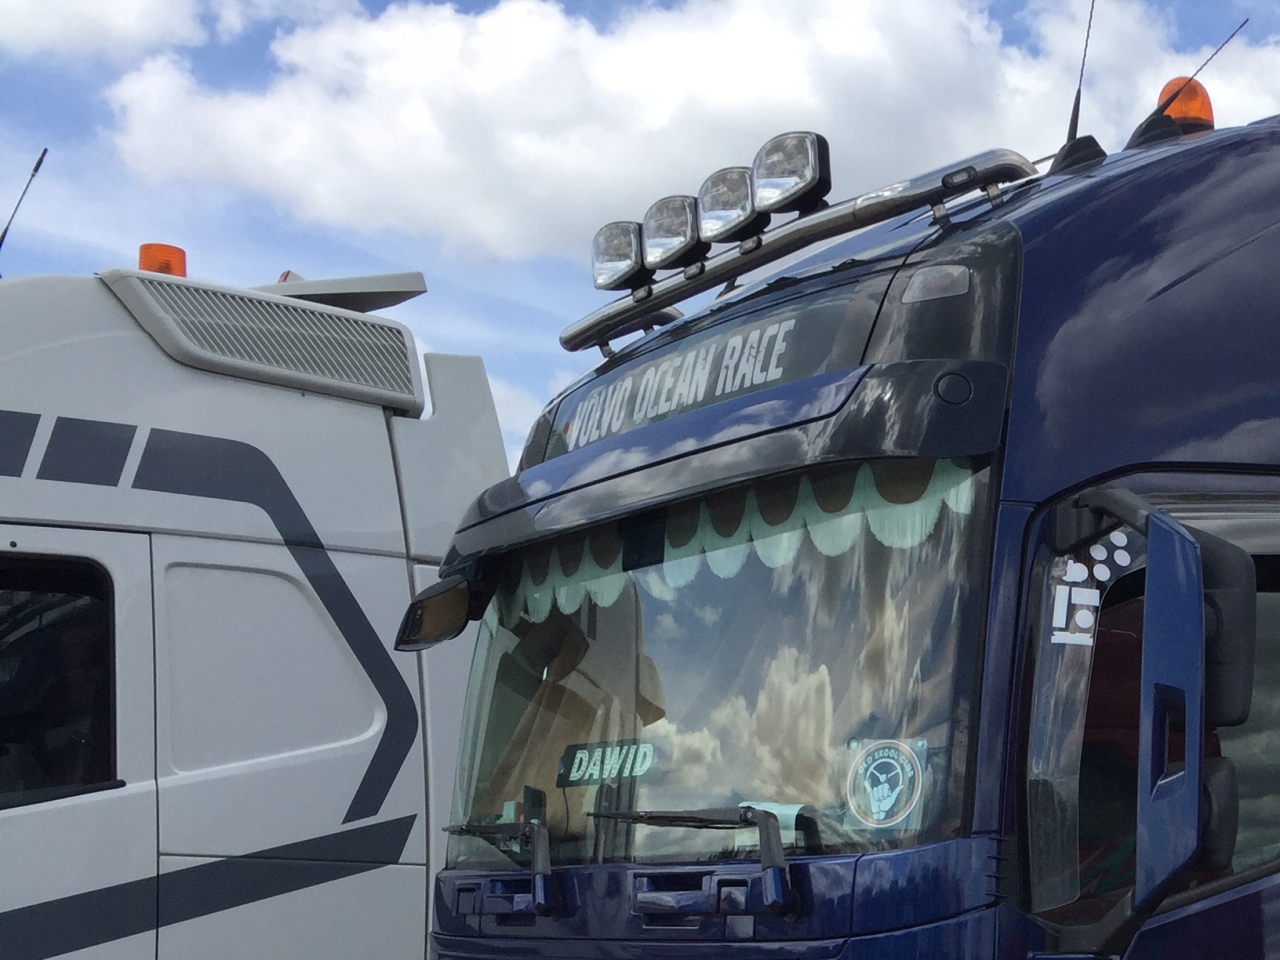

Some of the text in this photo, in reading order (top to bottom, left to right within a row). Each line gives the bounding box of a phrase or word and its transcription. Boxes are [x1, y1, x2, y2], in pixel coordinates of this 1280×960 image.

[568, 319, 796, 451] VOLVO OCEAN RACE
[568, 743, 654, 781] DAWID
[858, 756, 873, 775] OLD
[874, 748, 899, 760] SKOOL
